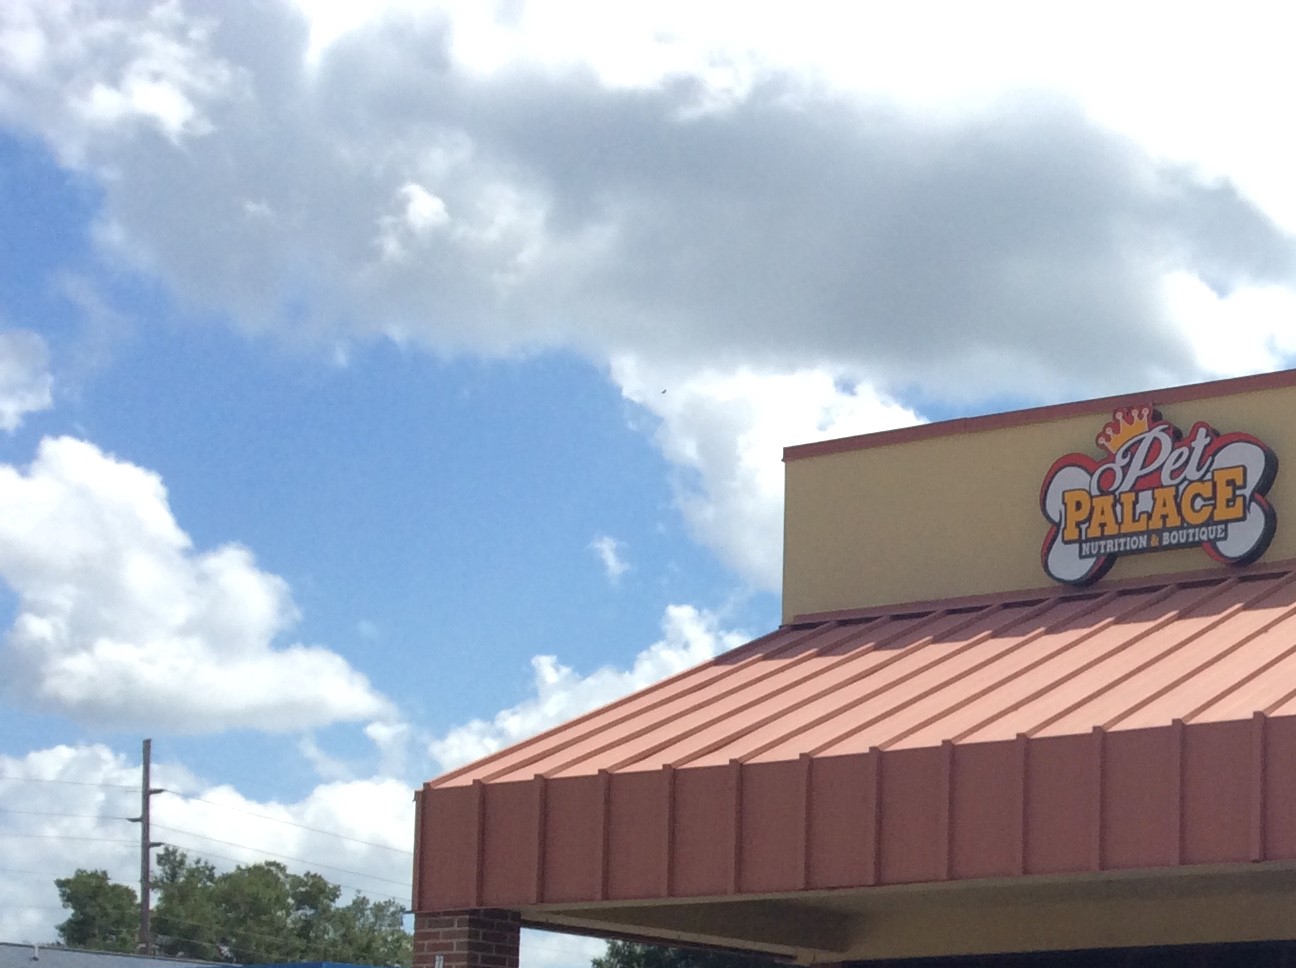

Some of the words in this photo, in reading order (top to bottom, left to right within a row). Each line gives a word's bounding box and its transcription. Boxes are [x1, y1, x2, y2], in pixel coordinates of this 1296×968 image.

[1091, 424, 1213, 495] Pet
[1063, 465, 1246, 542] PALACE
[1082, 534, 1148, 556] NUTRITION
[1150, 533, 1160, 548] &
[1162, 523, 1226, 545] BOUTIQUE
